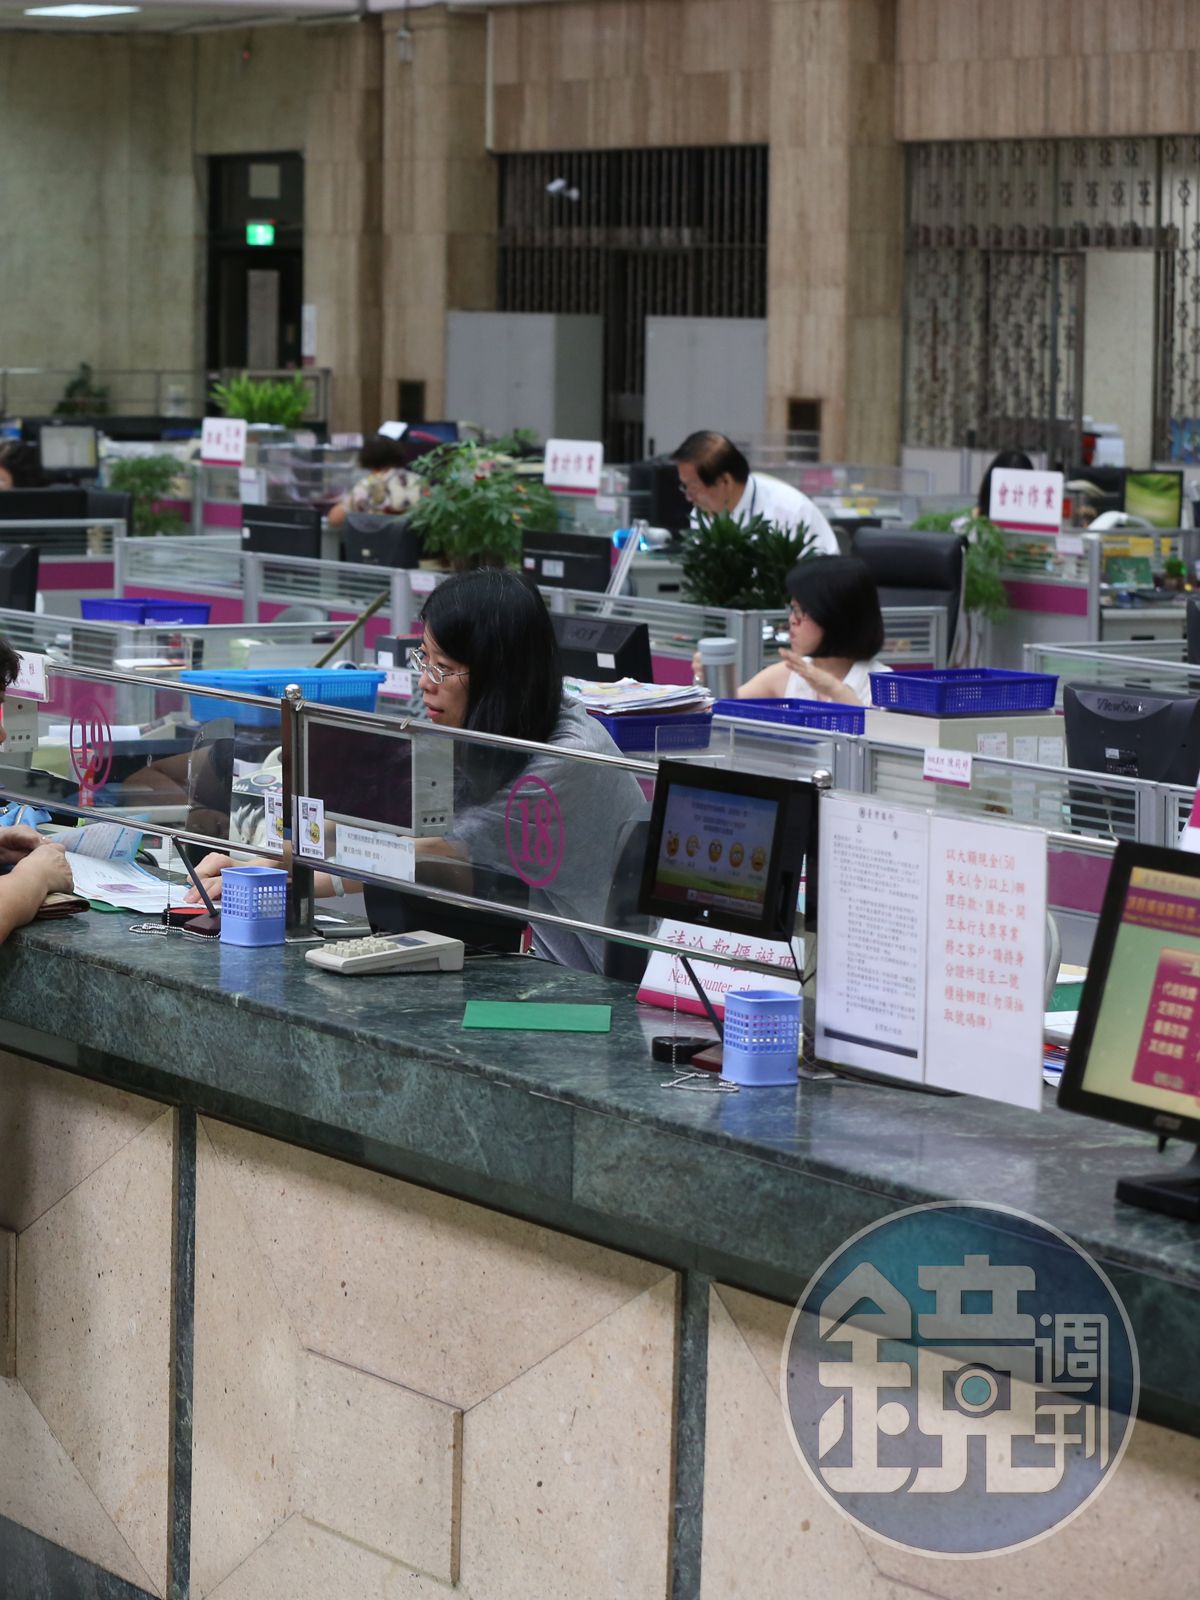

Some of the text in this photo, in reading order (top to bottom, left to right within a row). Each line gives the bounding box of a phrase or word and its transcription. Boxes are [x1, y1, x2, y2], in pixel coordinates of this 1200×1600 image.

[998, 482, 1054, 509] 會計作業
[517, 798, 553, 867] 18
